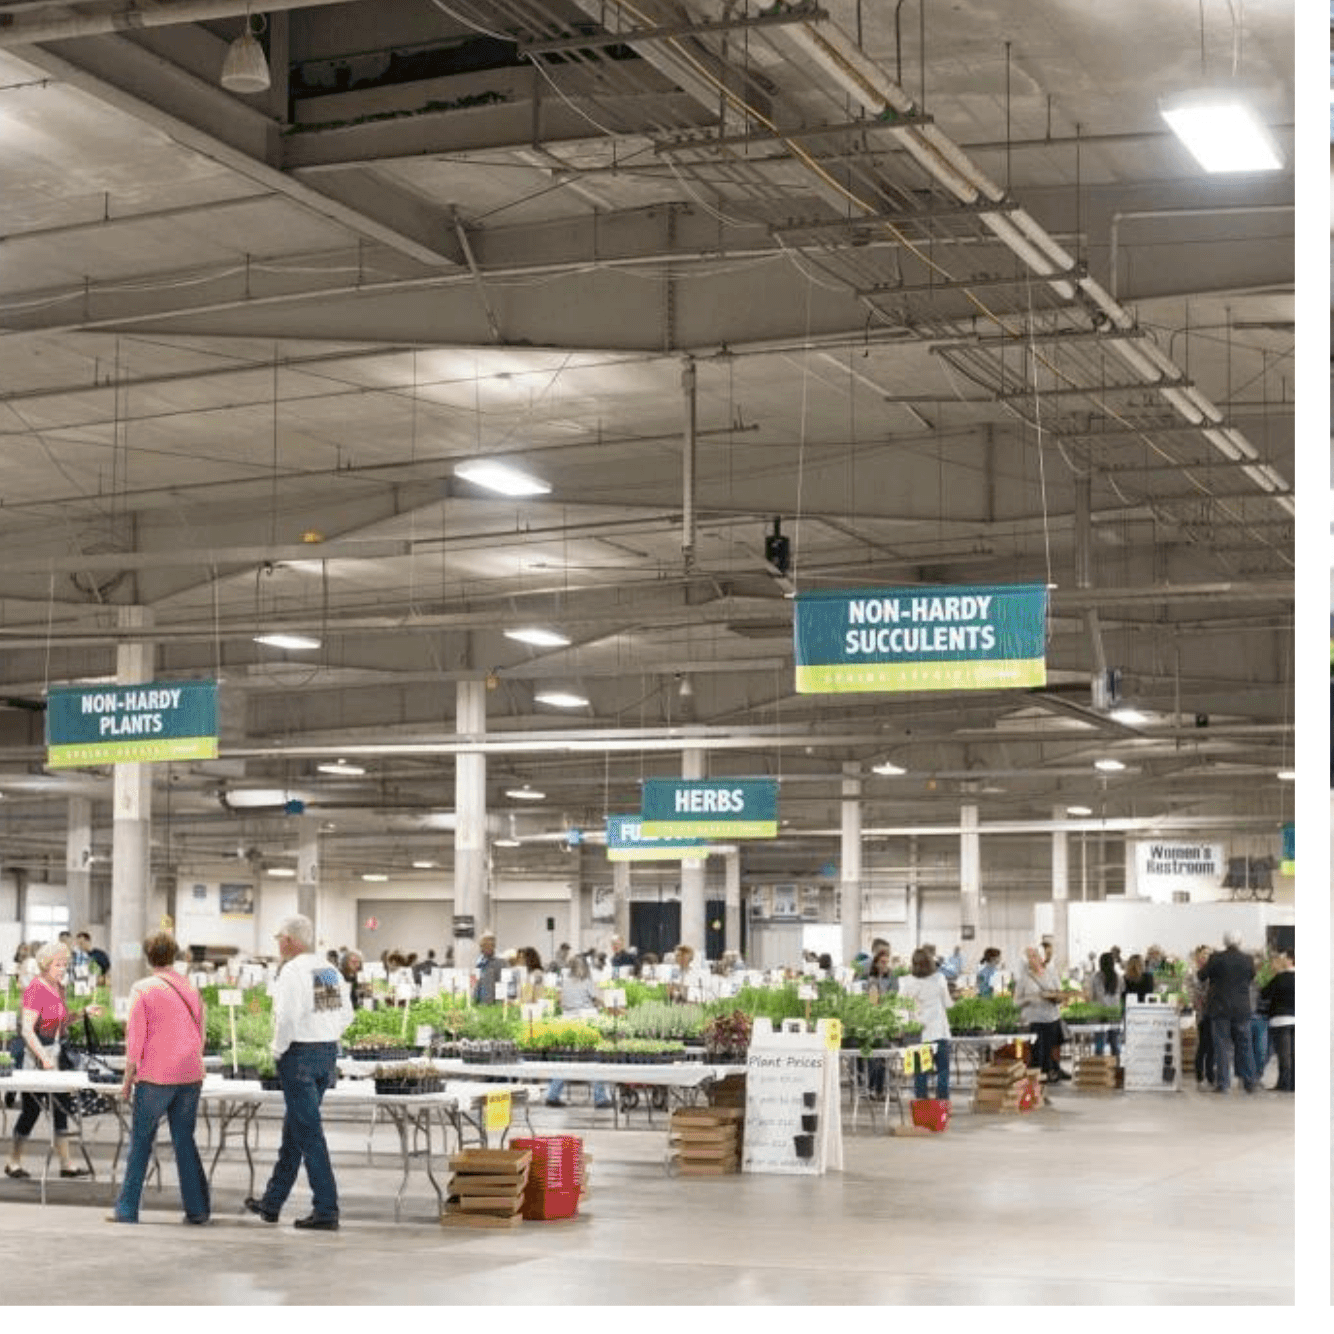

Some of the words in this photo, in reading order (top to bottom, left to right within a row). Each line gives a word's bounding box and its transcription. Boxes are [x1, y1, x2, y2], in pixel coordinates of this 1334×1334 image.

[848, 595, 993, 624] NON-HARDY
[845, 624, 995, 654] SUCCULENTS
[81, 688, 182, 715] NON-HARDY
[100, 714, 163, 736] PLANTS
[675, 788, 745, 813] HERBS
[1150, 844, 1212, 860] Women's
[1146, 860, 1215, 875] Restroom
